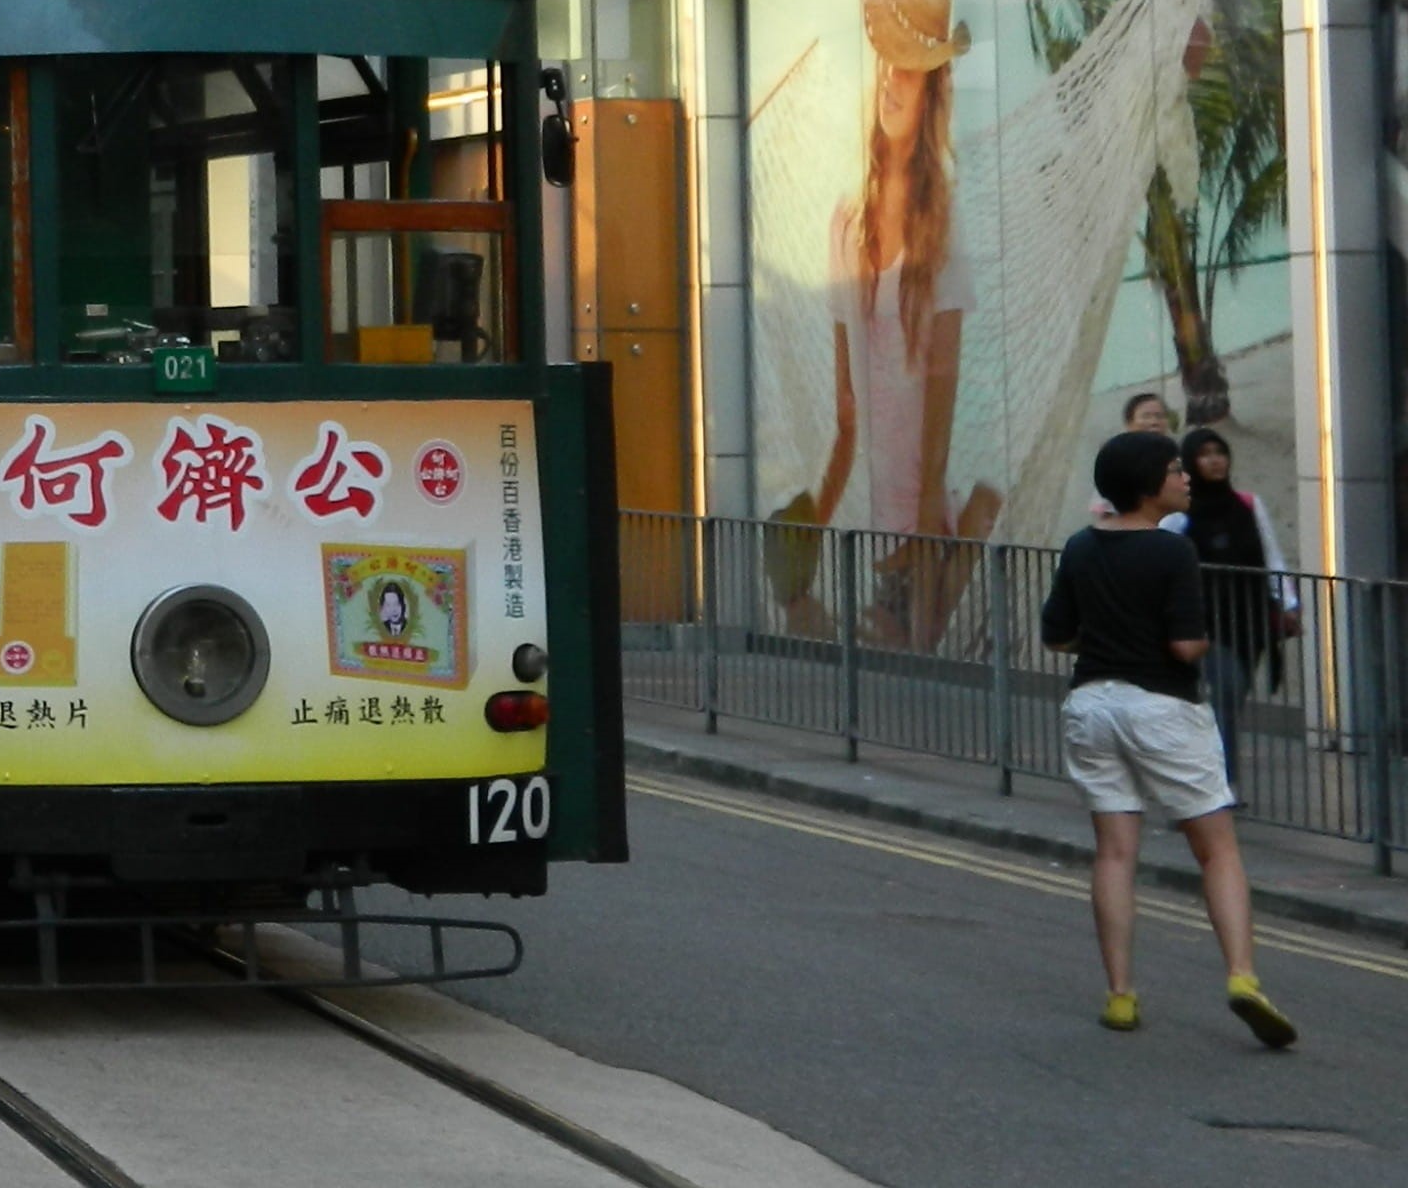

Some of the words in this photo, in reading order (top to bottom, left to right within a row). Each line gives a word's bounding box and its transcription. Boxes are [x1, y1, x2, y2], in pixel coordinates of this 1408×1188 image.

[164, 356, 208, 380] 021
[0, 420, 388, 536] 何濟公
[499, 424, 526, 619] 百份百香港製造
[290, 694, 447, 726] 止痛退熱散
[468, 776, 551, 844] 120
